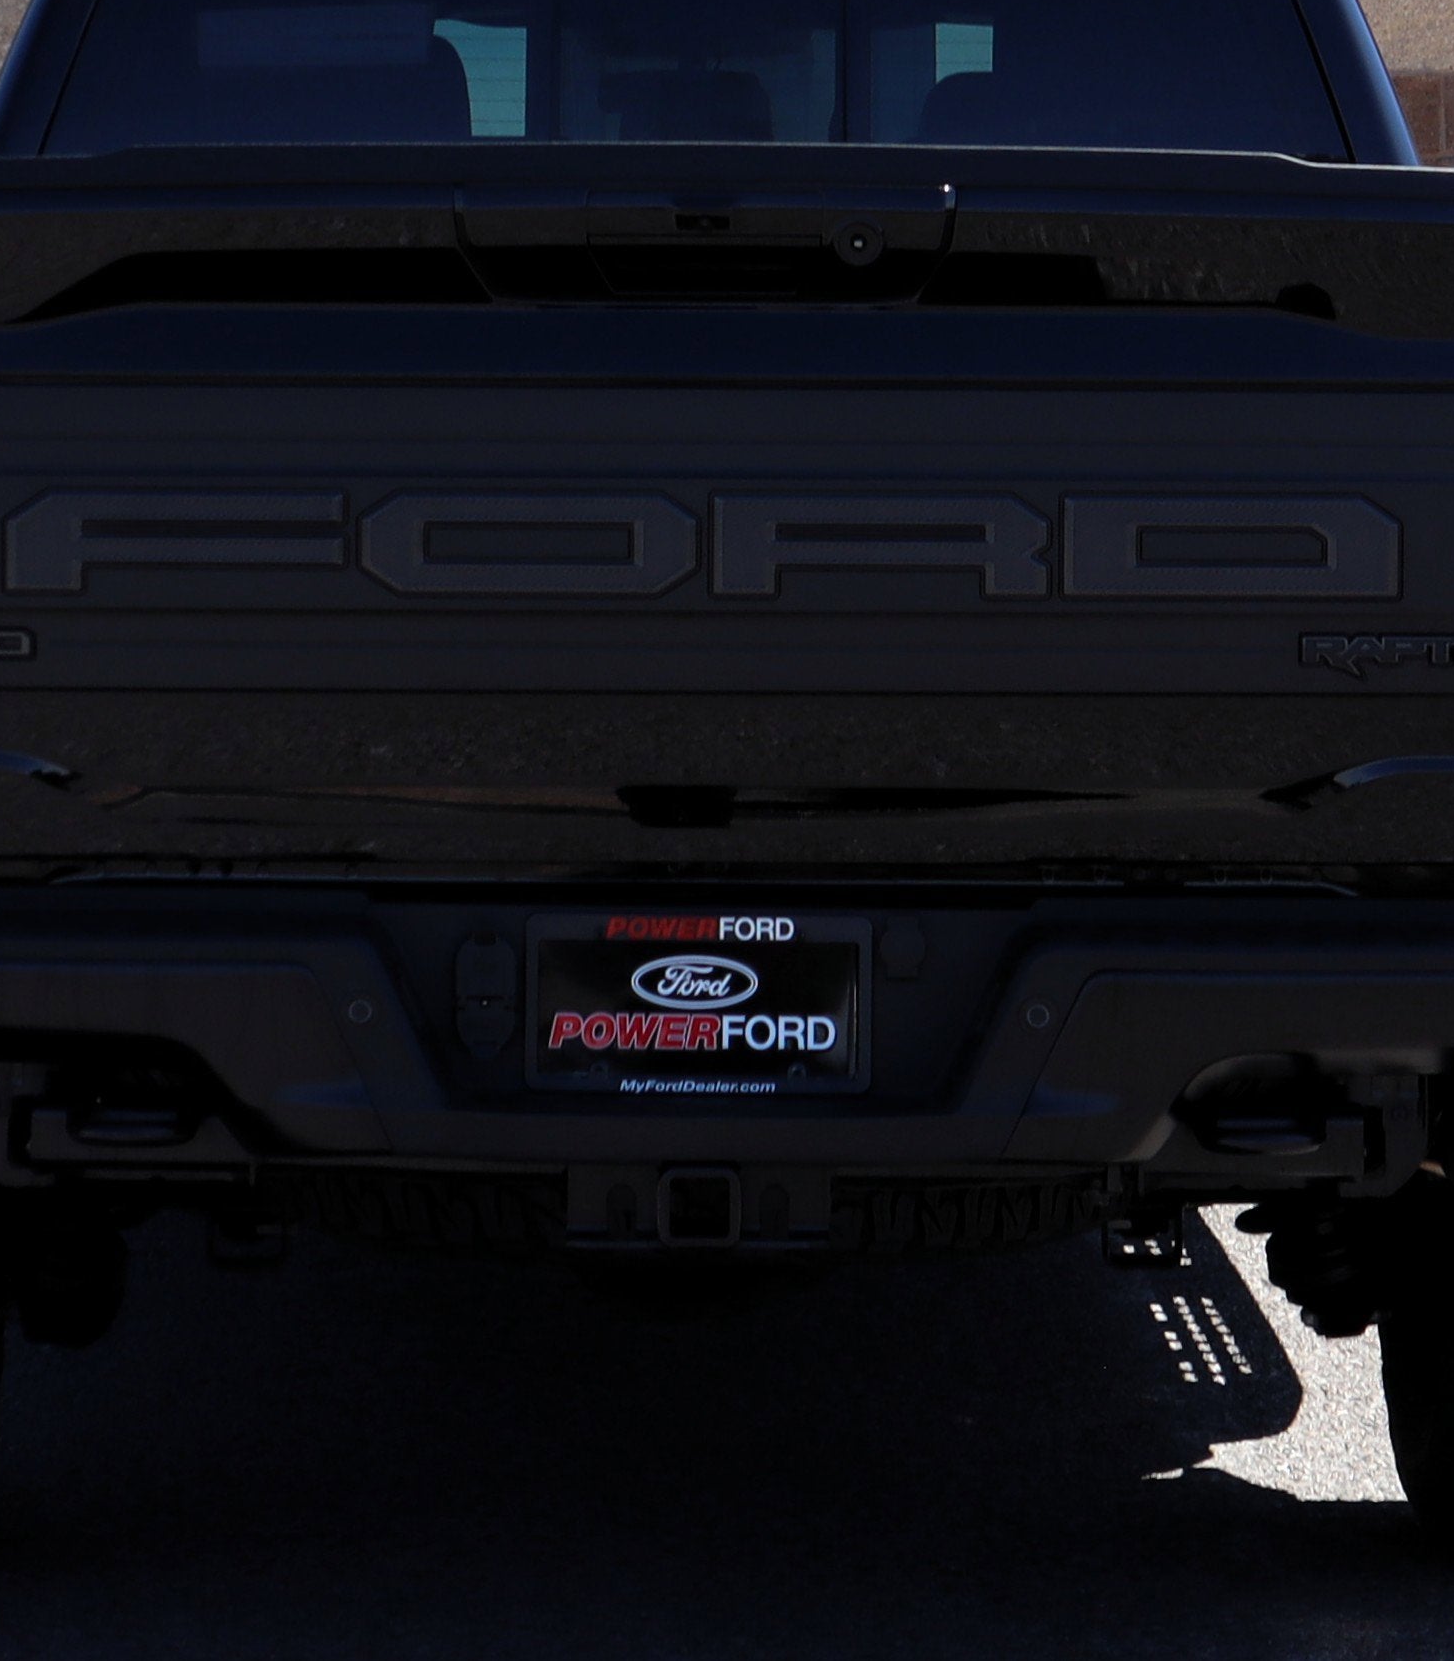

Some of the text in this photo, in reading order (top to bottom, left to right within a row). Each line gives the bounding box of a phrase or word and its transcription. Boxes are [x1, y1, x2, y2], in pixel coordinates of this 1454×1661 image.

[3, 488, 1403, 597] FORD
[657, 964, 730, 999] Ford
[620, 1079, 776, 1094] MyFordDealer.com
